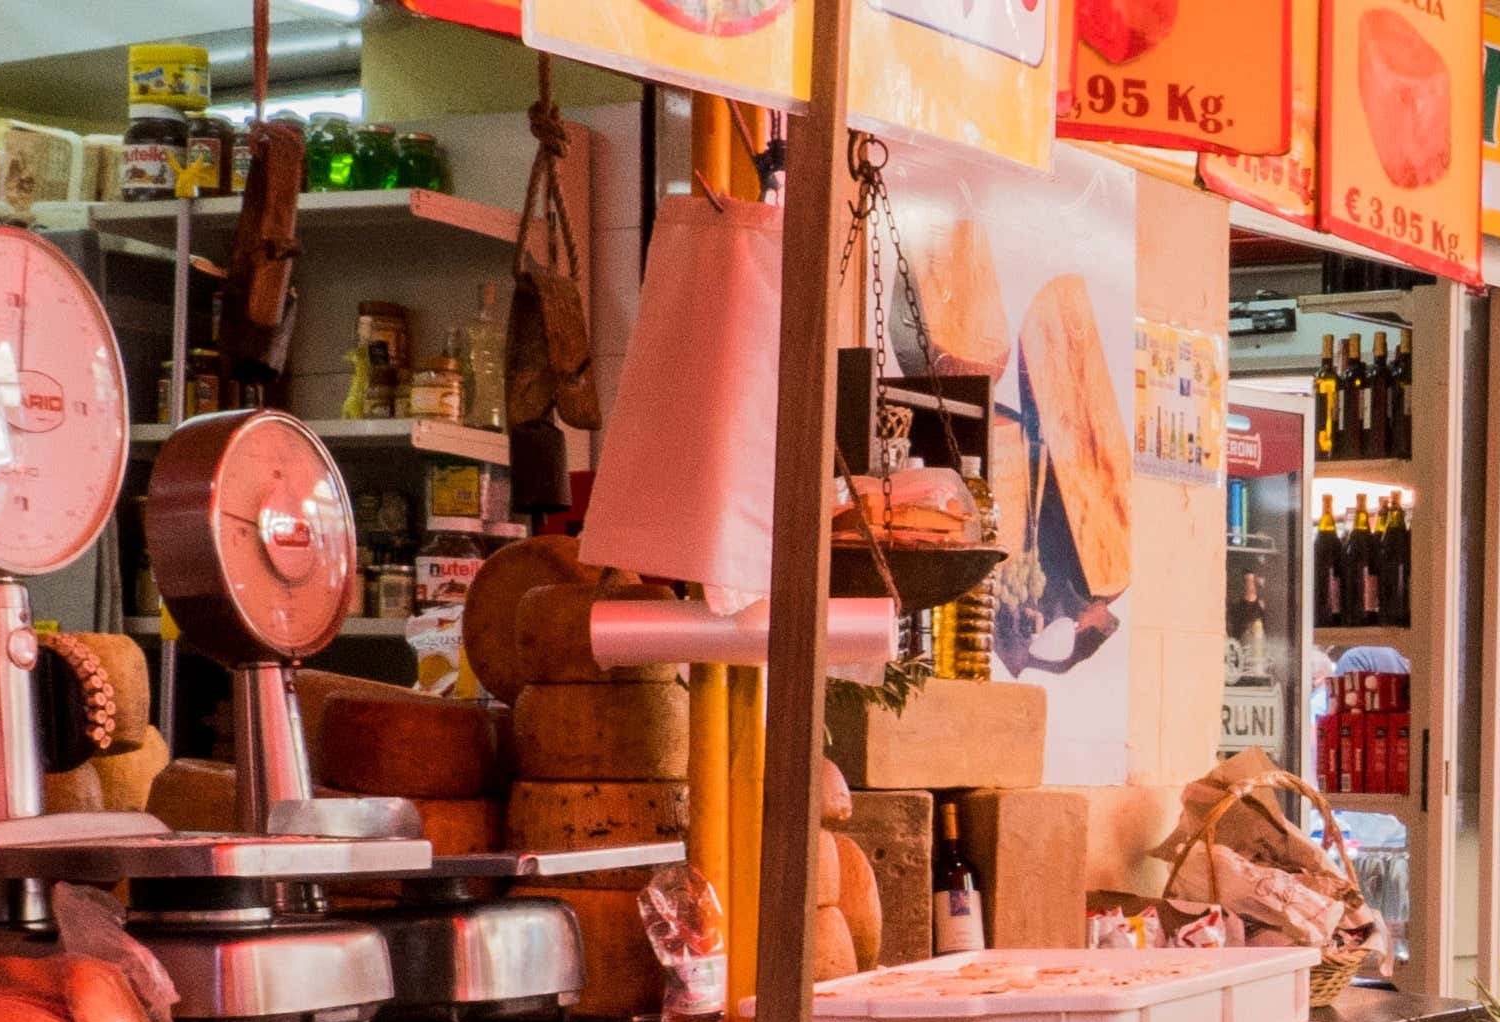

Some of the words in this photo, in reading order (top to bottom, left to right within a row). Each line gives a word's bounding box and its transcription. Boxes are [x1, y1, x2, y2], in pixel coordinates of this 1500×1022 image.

[1057, 74, 1150, 120] ,95
[1167, 83, 1234, 135] Kg.
[1430, 217, 1466, 262] Kg.
[429, 559, 484, 578] nutell
